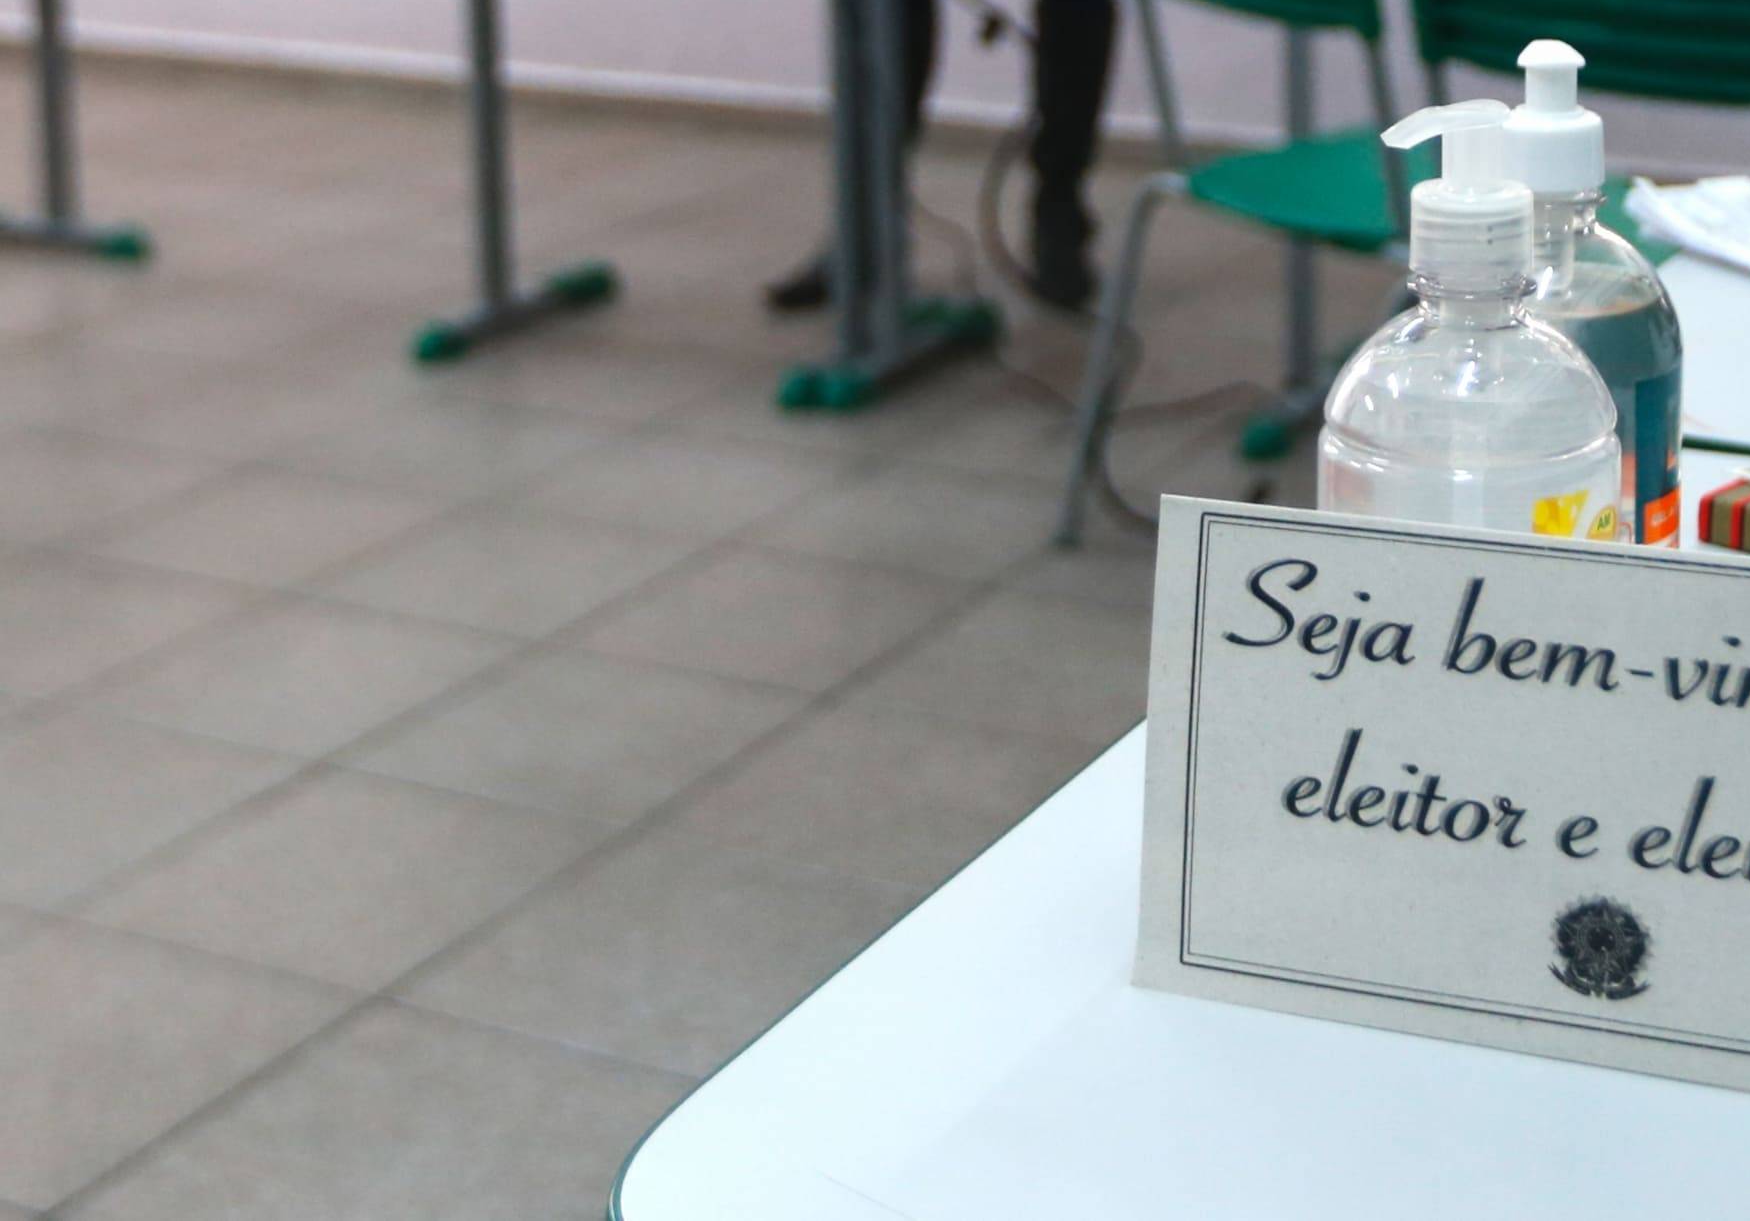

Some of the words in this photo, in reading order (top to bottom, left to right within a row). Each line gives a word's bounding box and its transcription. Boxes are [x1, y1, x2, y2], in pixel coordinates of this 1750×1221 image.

[1223, 558, 1416, 682] Seja
[1281, 727, 1527, 851] eleitor
[1554, 814, 1600, 860] e
